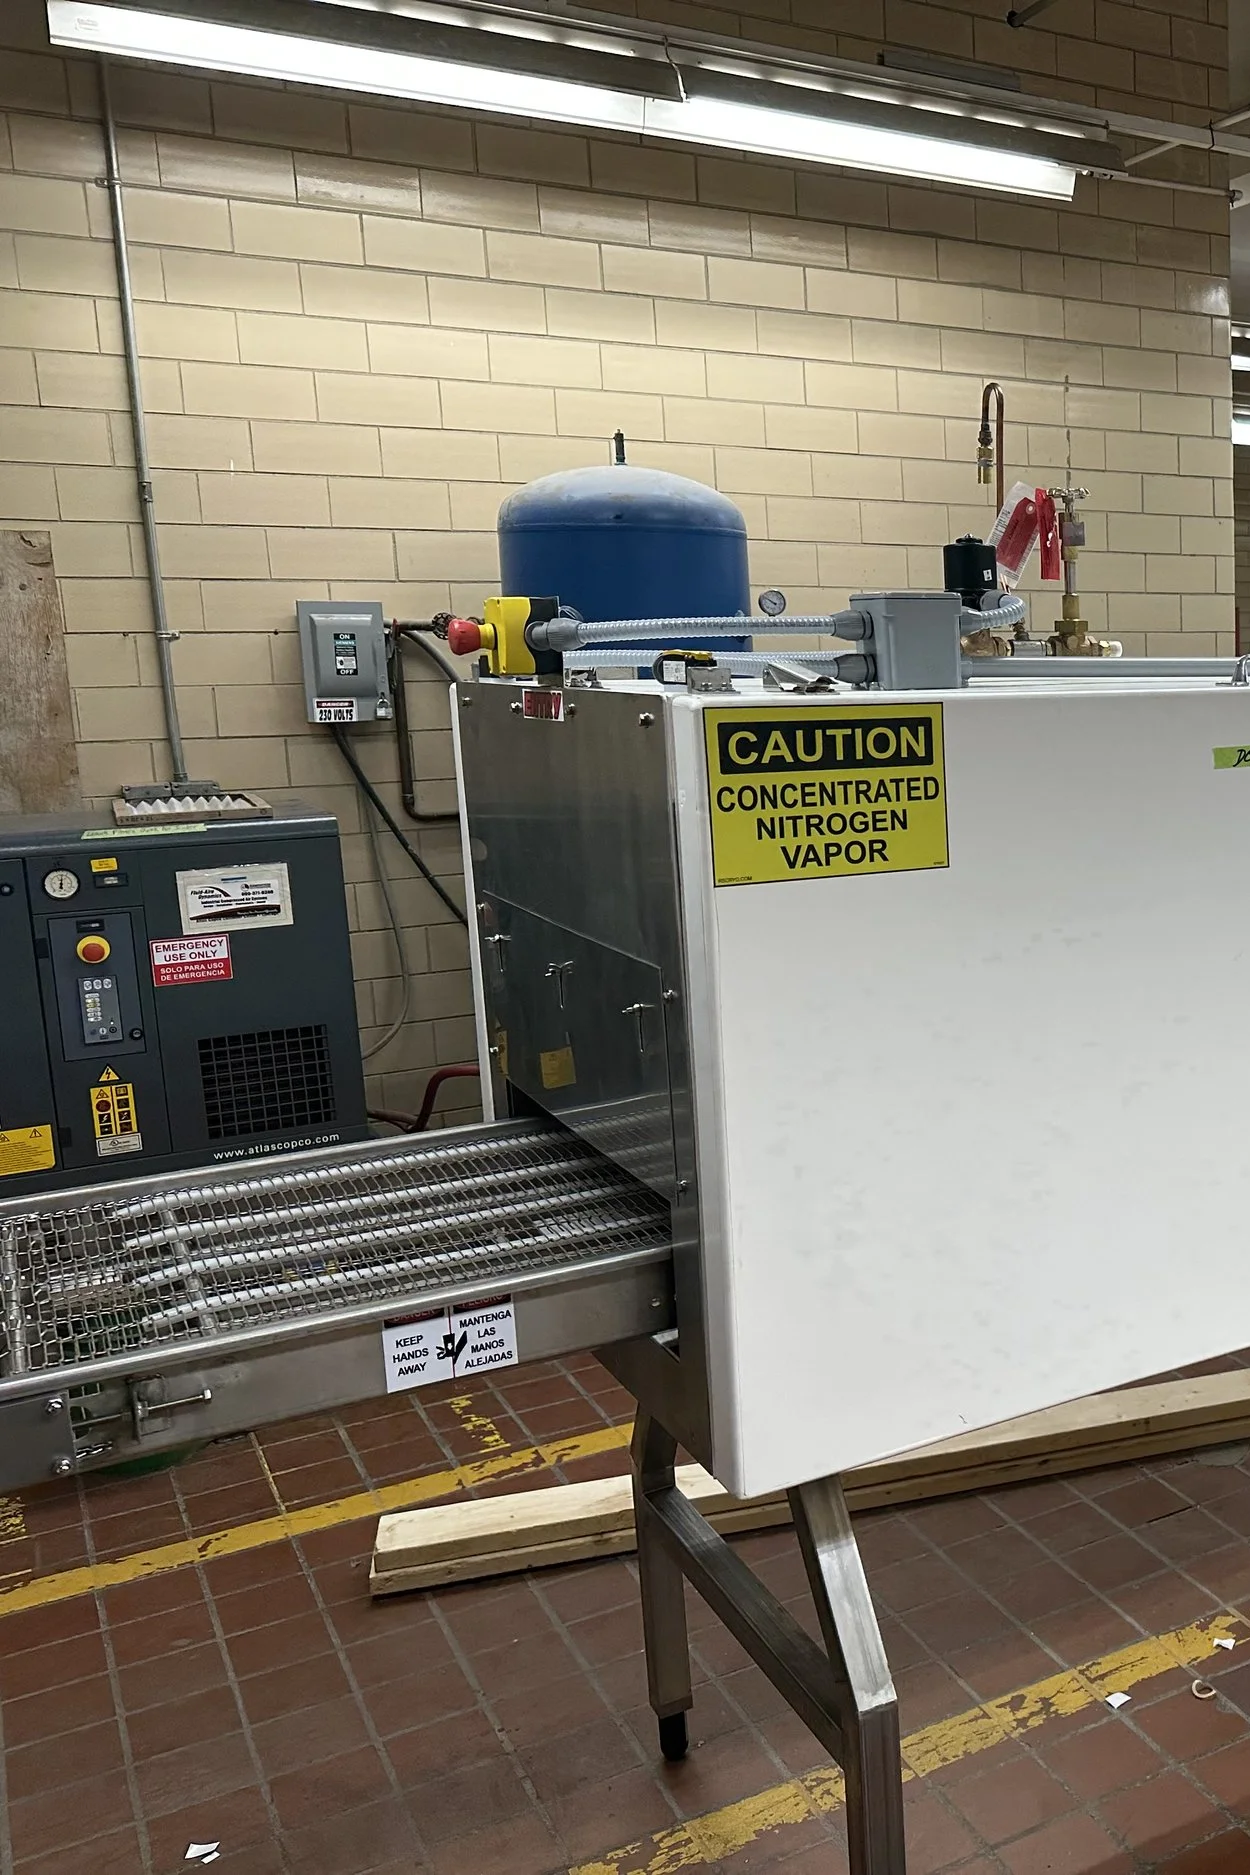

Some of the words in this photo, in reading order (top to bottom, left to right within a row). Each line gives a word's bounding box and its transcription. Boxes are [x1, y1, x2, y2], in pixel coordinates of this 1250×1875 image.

[319, 709, 331, 721] 230
[334, 709, 353, 720] VOLTS
[728, 725, 926, 766] CAUTION
[716, 776, 940, 813] CONCENTRATED
[756, 809, 908, 841] NITROGEN
[780, 839, 889, 869] VAPOR
[155, 939, 223, 952] EMERGENCY
[164, 953, 186, 962] USE
[189, 950, 217, 959] ONLY
[174, 970, 225, 980] EMERGENCIA
[214, 1133, 340, 1160] www.atlascopco.com
[459, 1310, 512, 1329] MANTENGA
[478, 1327, 496, 1339] LAS
[395, 1335, 424, 1348] KEEP
[471, 1339, 505, 1353] MANOS
[393, 1348, 429, 1364] HANDS
[464, 1350, 513, 1369] ALEJADAS
[397, 1362, 427, 1376] AWAY
